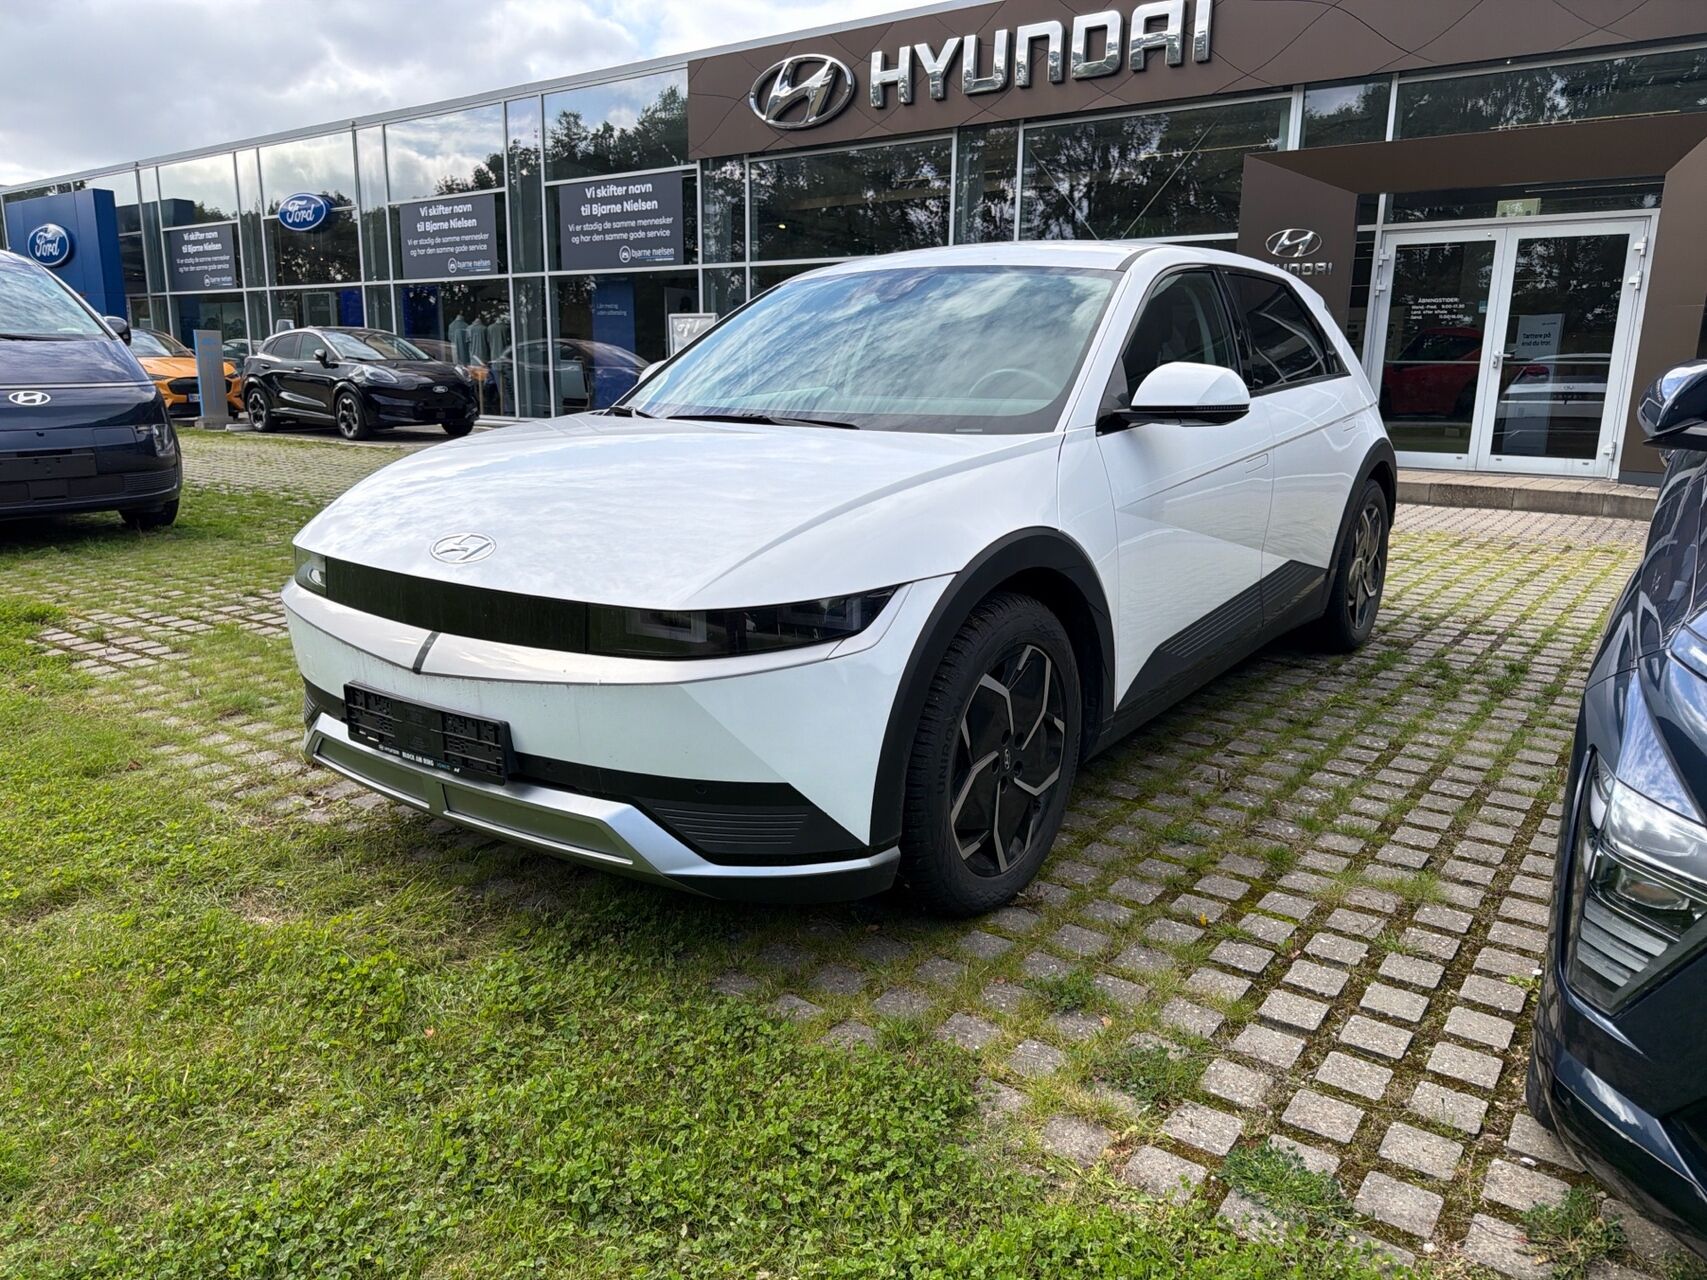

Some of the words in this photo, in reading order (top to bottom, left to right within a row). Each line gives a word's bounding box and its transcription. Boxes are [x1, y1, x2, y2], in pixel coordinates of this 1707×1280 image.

[870, 0, 1214, 109] HYUNDAI
[585, 187, 595, 198] Vi
[597, 185, 626, 197] skifter
[629, 183, 652, 194] navn
[286, 200, 315, 223] Ford
[420, 207, 428, 216] Vi
[429, 205, 452, 216] skifter
[454, 204, 472, 213] navn
[581, 203, 590, 215] til
[592, 202, 622, 216] Bjarne
[623, 199, 658, 212] Nielsen
[426, 220, 448, 232] Bjarne
[450, 217, 477, 228] Nielsen
[568, 224, 575, 232] Vi
[583, 222, 602, 231] stadig
[604, 221, 611, 229] de
[613, 220, 635, 228] samme
[637, 216, 673, 226] mennesker
[35, 231, 60, 257] Ford
[571, 236, 579, 244] og
[580, 234, 591, 242] har
[592, 233, 604, 241] den
[605, 232, 628, 240] samme
[629, 230, 645, 240] gode
[647, 228, 670, 237] service
[631, 248, 651, 258] bjarne
[652, 246, 674, 256] nielsen
[1272, 262, 1333, 276] NDAI
